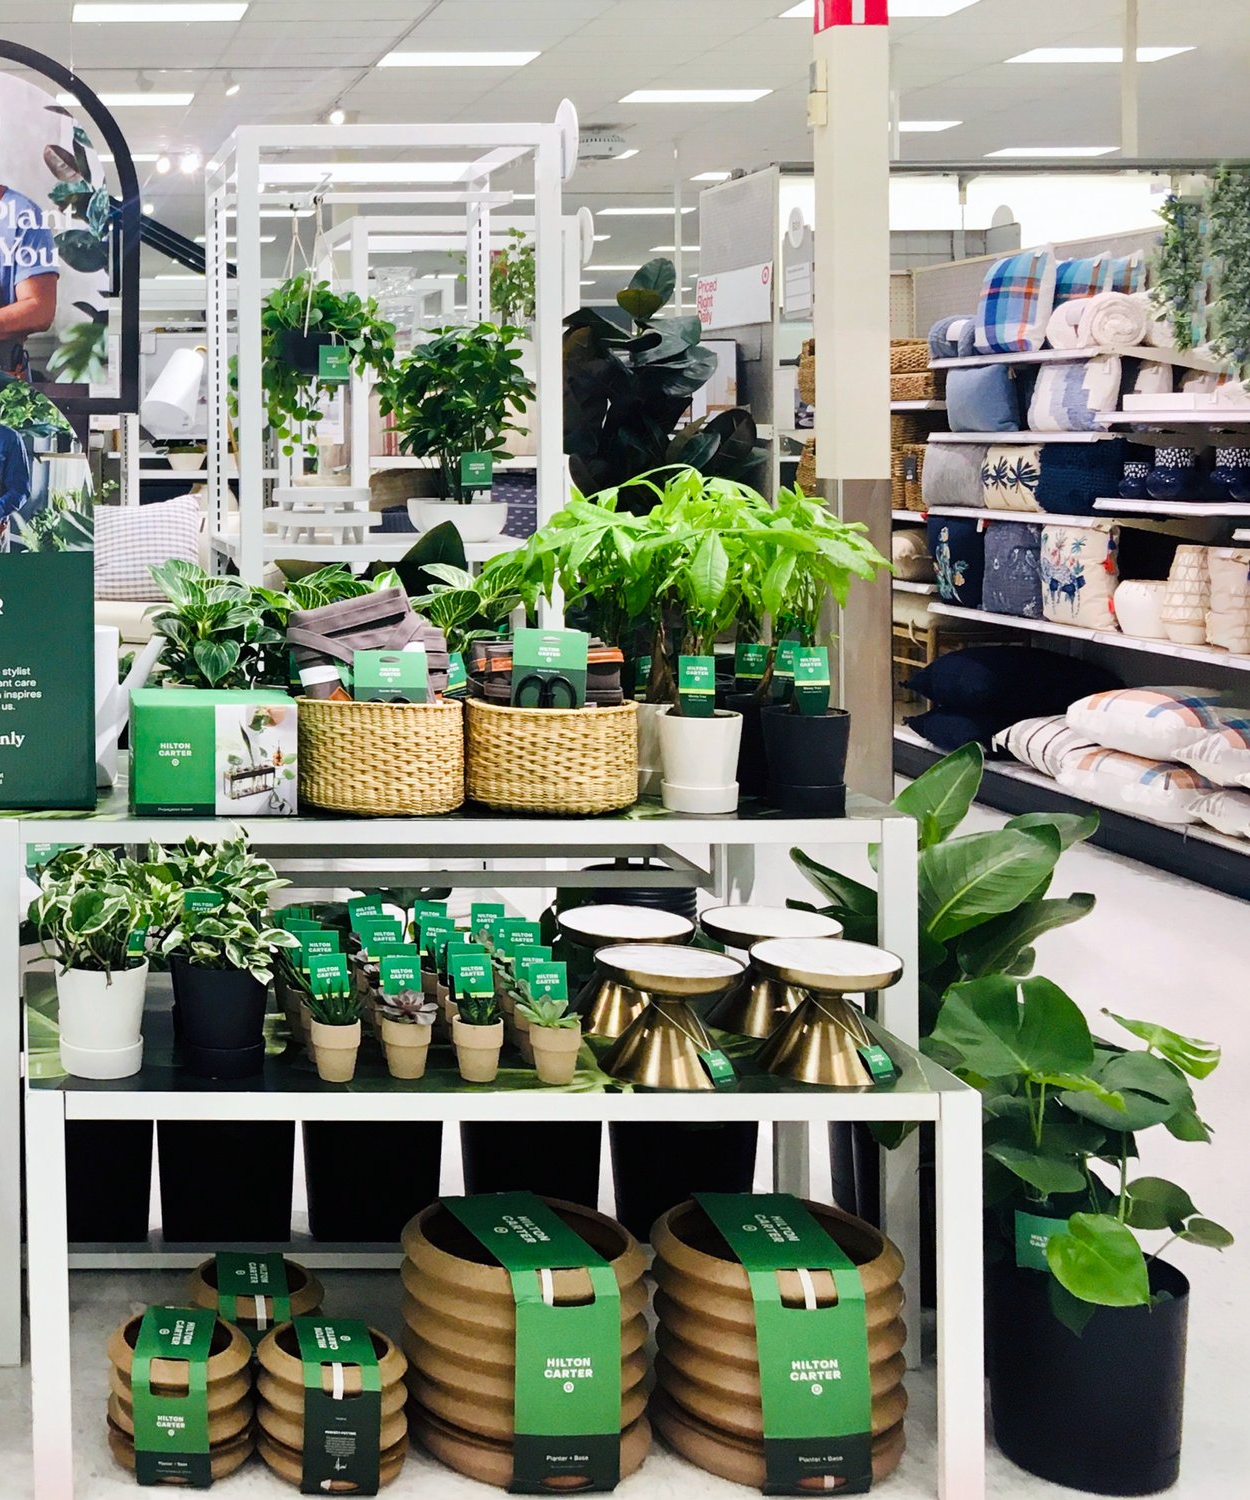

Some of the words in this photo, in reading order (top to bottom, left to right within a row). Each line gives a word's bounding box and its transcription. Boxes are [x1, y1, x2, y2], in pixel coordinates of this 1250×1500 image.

[2, 667, 31, 677] stylist
[14, 680, 37, 688] care
[4, 690, 42, 700] inspires
[502, 1216, 536, 1243] CARTER
[517, 1216, 550, 1242] HILTON
[754, 1214, 784, 1242] CARTER
[770, 1216, 800, 1241] HILTON
[248, 1262, 258, 1284] CARTER
[259, 1263, 269, 1283] HILTON
[171, 1320, 185, 1346] CARTER
[182, 1322, 196, 1346] HILTON
[314, 1327, 327, 1348] HILTON
[325, 1326, 338, 1350] CARTER
[546, 1358, 591, 1368] HILTON
[791, 1360, 838, 1370] HILTON
[544, 1368, 593, 1379] CARTER
[790, 1370, 842, 1382] CARTER
[546, 1454, 568, 1462] Planter
[574, 1454, 589, 1462] Base
[798, 1456, 820, 1464] Planter
